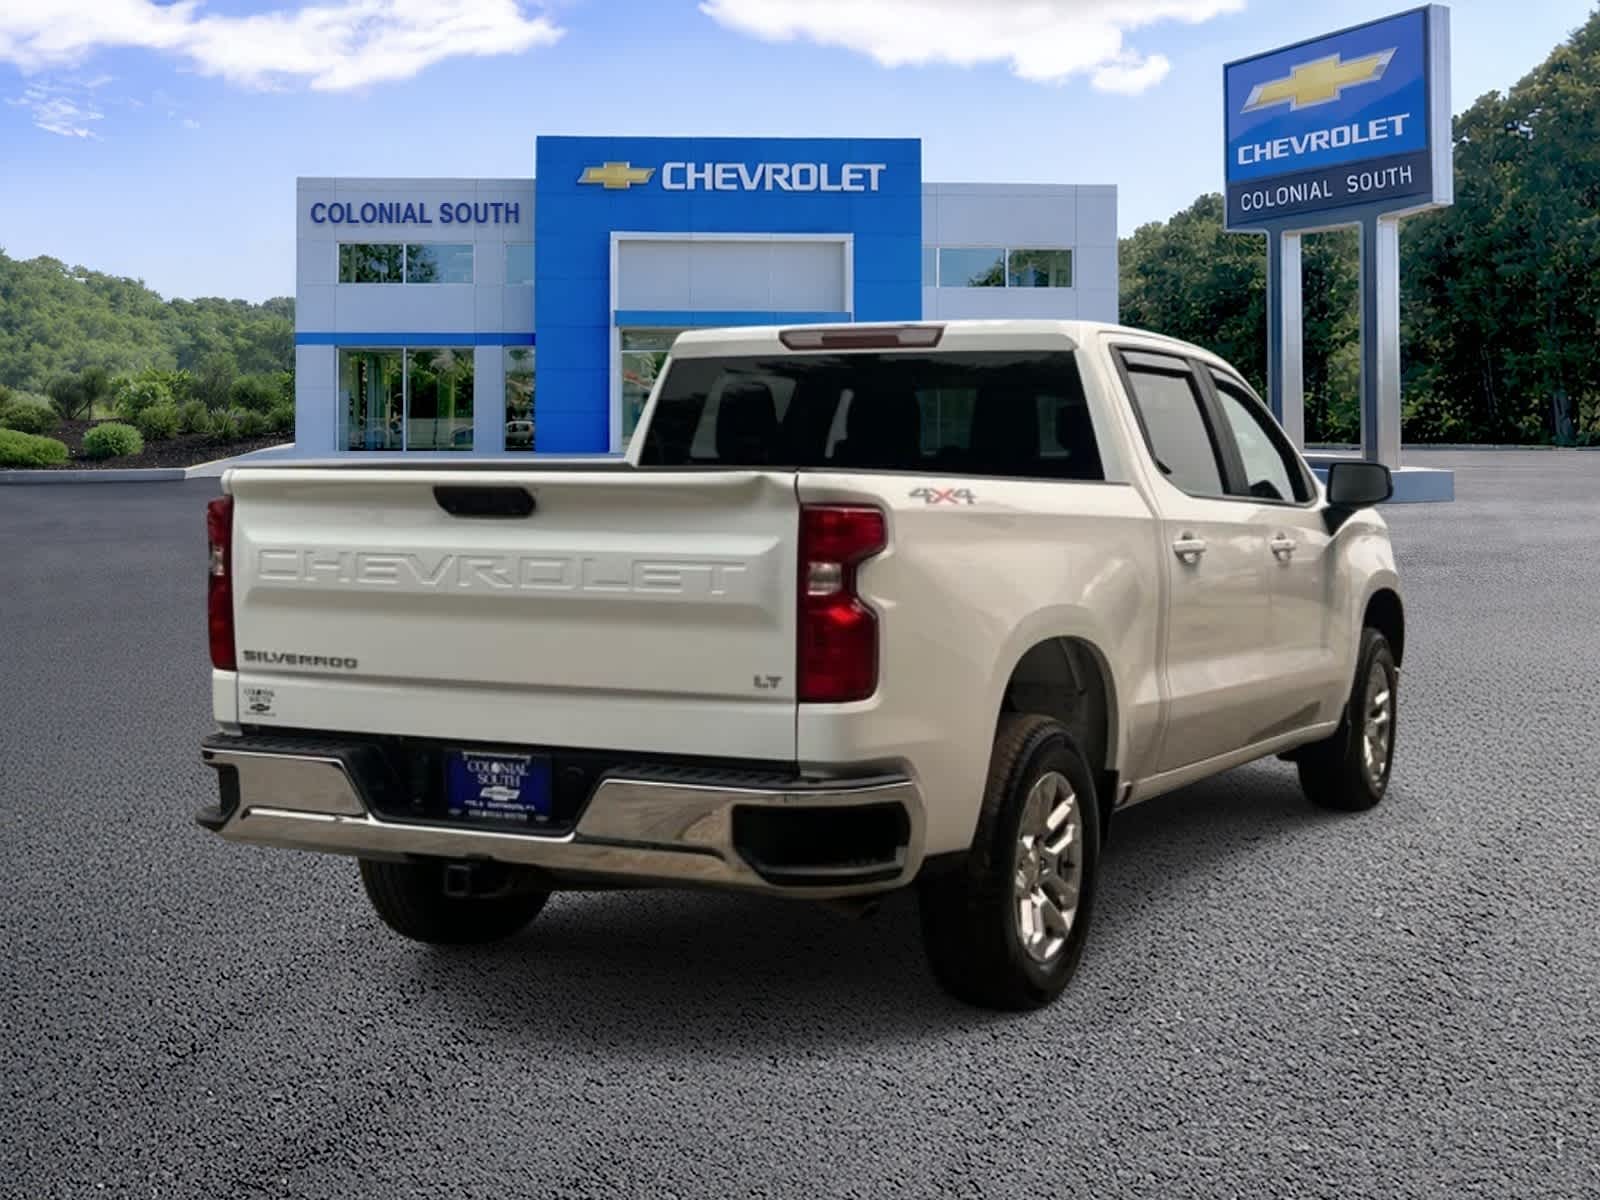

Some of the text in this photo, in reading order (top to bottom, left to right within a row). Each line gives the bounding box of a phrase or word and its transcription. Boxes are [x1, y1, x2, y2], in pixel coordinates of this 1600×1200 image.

[1237, 113, 1410, 165] CHEVROLET
[661, 161, 886, 193] CHEVROLET
[1240, 165, 1413, 212] COLONIAL SOUTH
[310, 202, 520, 225] COLONIAL SOUTH
[256, 548, 748, 595] CHEVROLET
[242, 649, 358, 669] SILVERADO
[753, 674, 783, 689] LT
